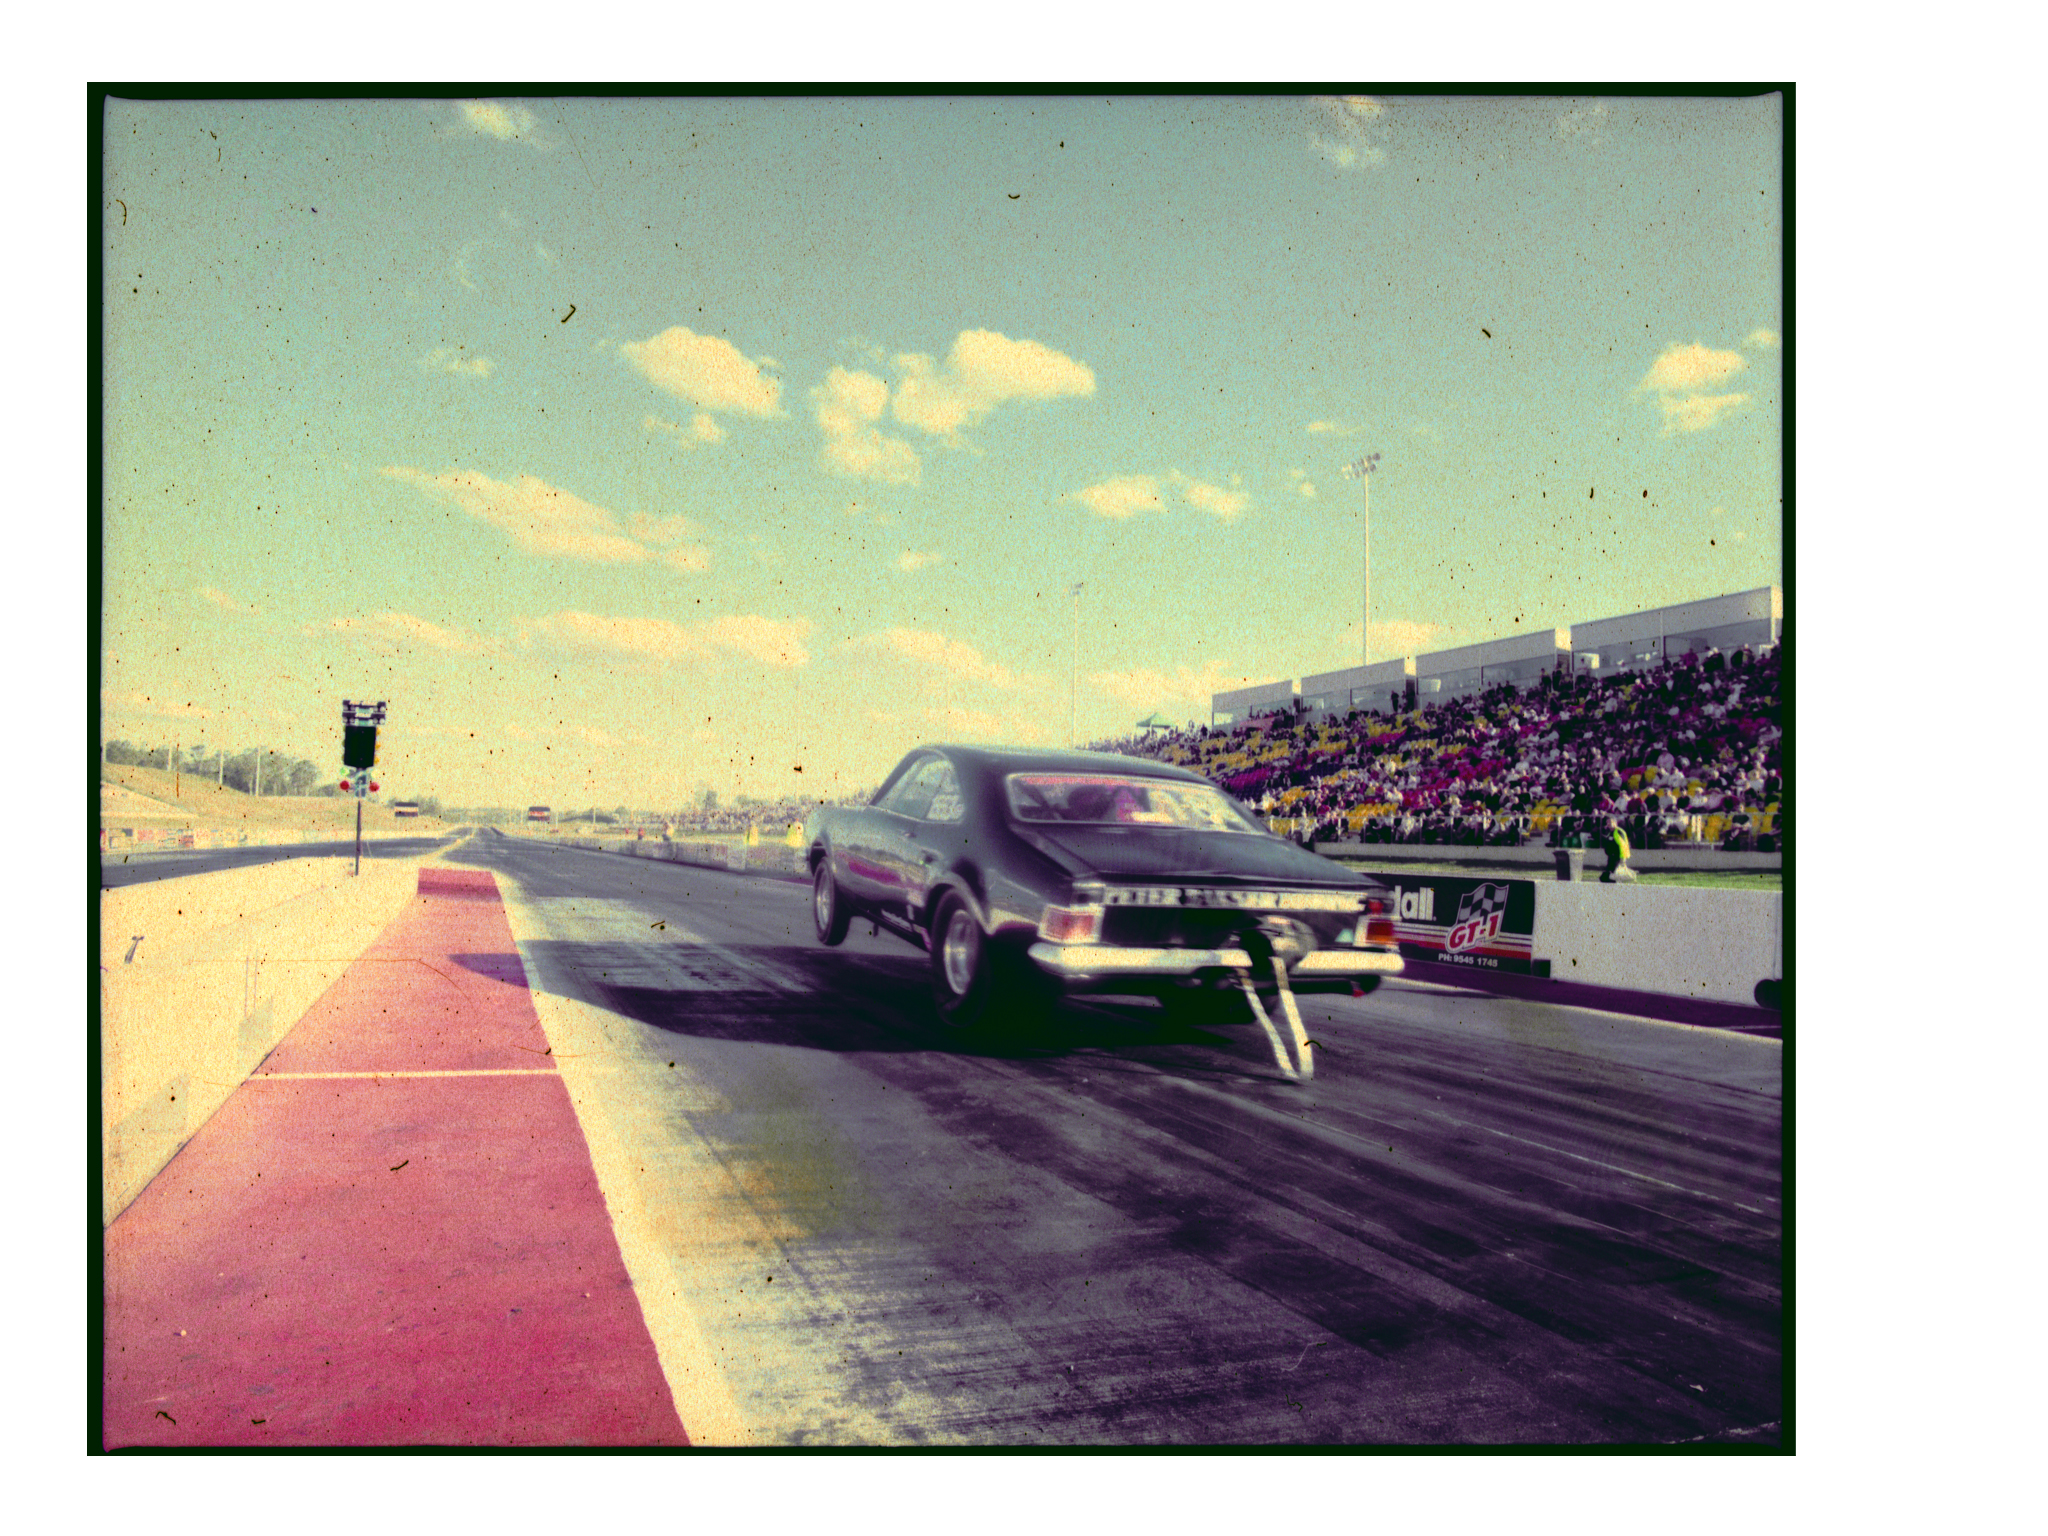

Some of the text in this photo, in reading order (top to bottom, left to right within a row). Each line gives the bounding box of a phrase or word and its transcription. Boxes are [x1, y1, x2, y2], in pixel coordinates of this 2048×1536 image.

[1448, 912, 1501, 951] GT-1
[1438, 953, 1498, 968] PH: 9545 1745
